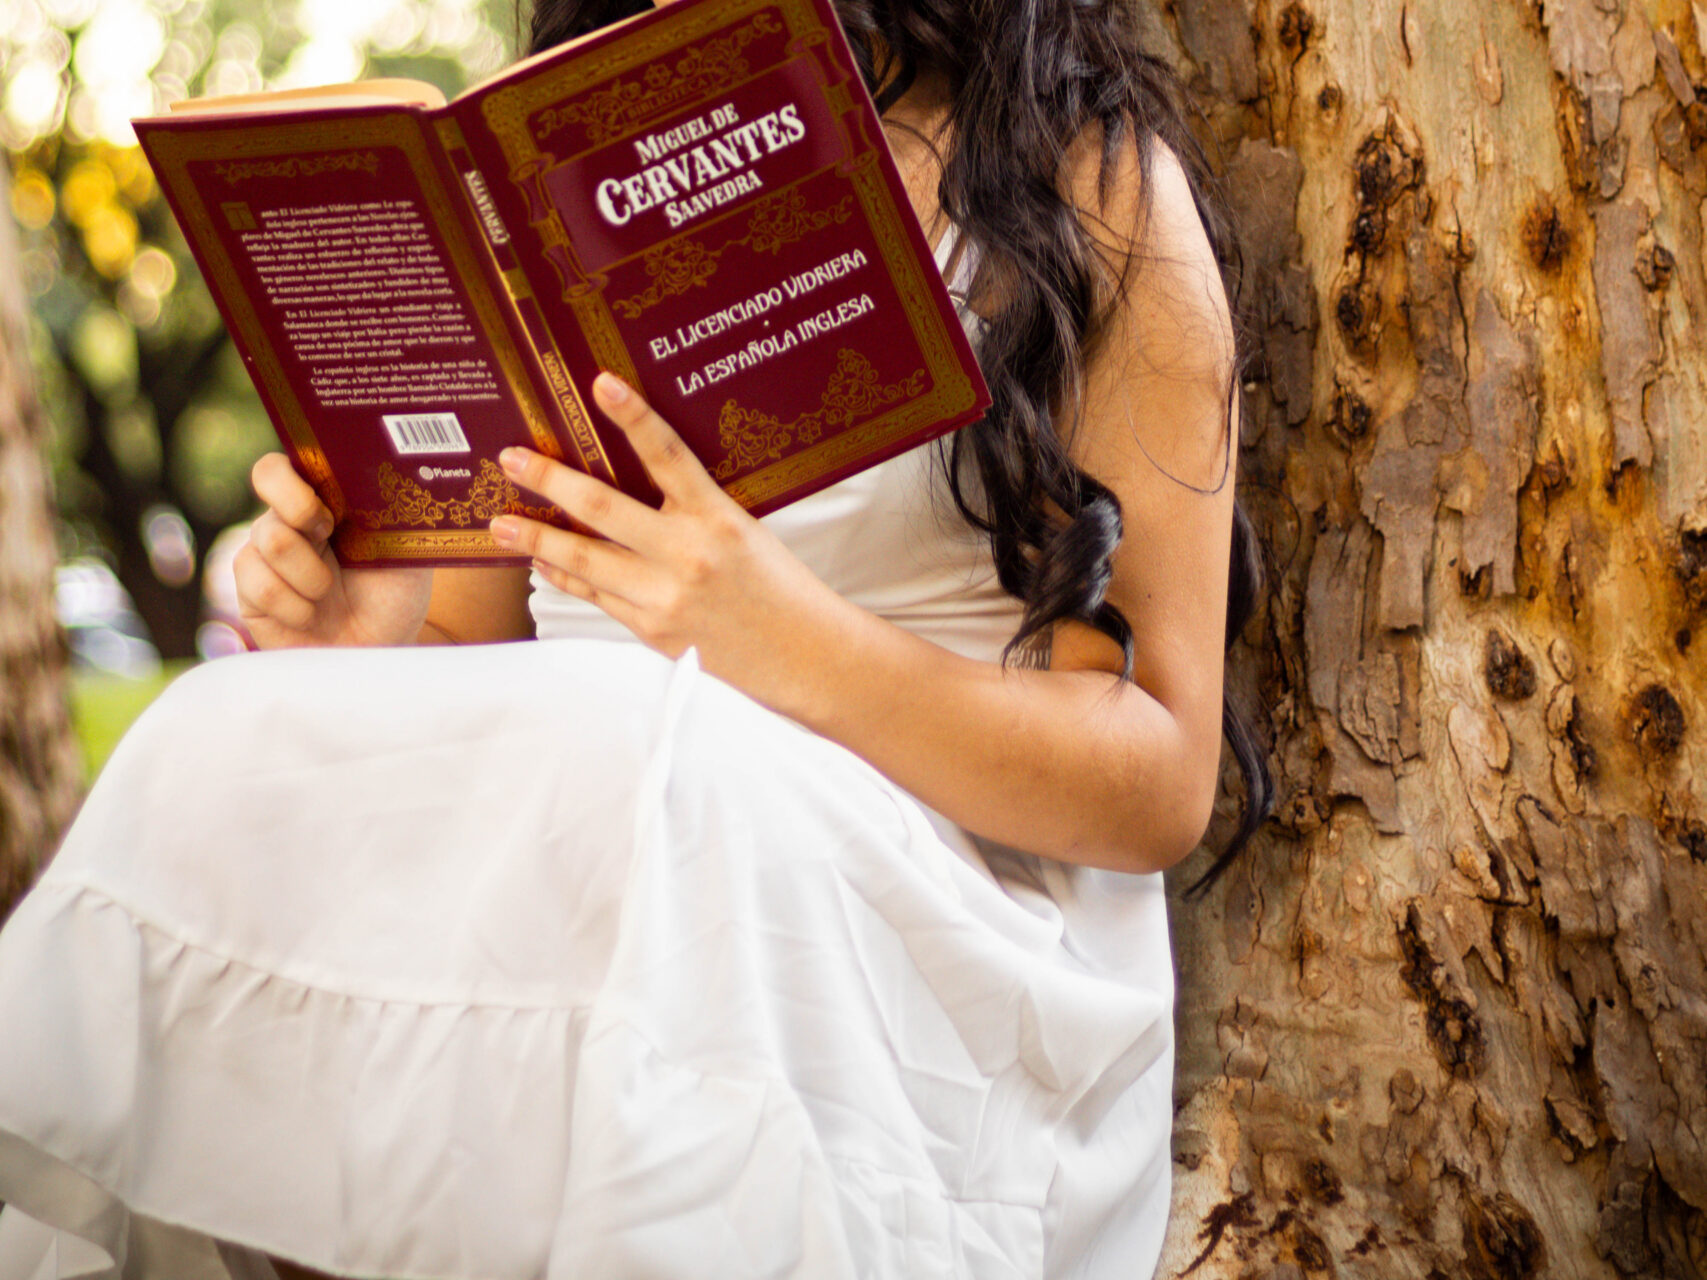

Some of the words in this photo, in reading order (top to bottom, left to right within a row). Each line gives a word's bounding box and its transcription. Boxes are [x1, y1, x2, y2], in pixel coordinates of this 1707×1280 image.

[626, 77, 710, 121] BIBLIOTECA
[596, 102, 806, 226] CERVANTES
[634, 116, 713, 165] MIGUEL
[710, 102, 739, 130] DE
[464, 169, 510, 244] CERVANTES
[664, 169, 764, 228] SAAVEDRA
[650, 336, 678, 360] EL
[676, 286, 783, 348] LICENCIADO
[781, 248, 868, 299] VIDRIERA
[676, 371, 705, 396] LA
[703, 328, 798, 384] ESPAÑOLA
[797, 293, 875, 342] INGLESA
[433, 467, 471, 478] Planeta
[585, 447, 600, 462] EL
